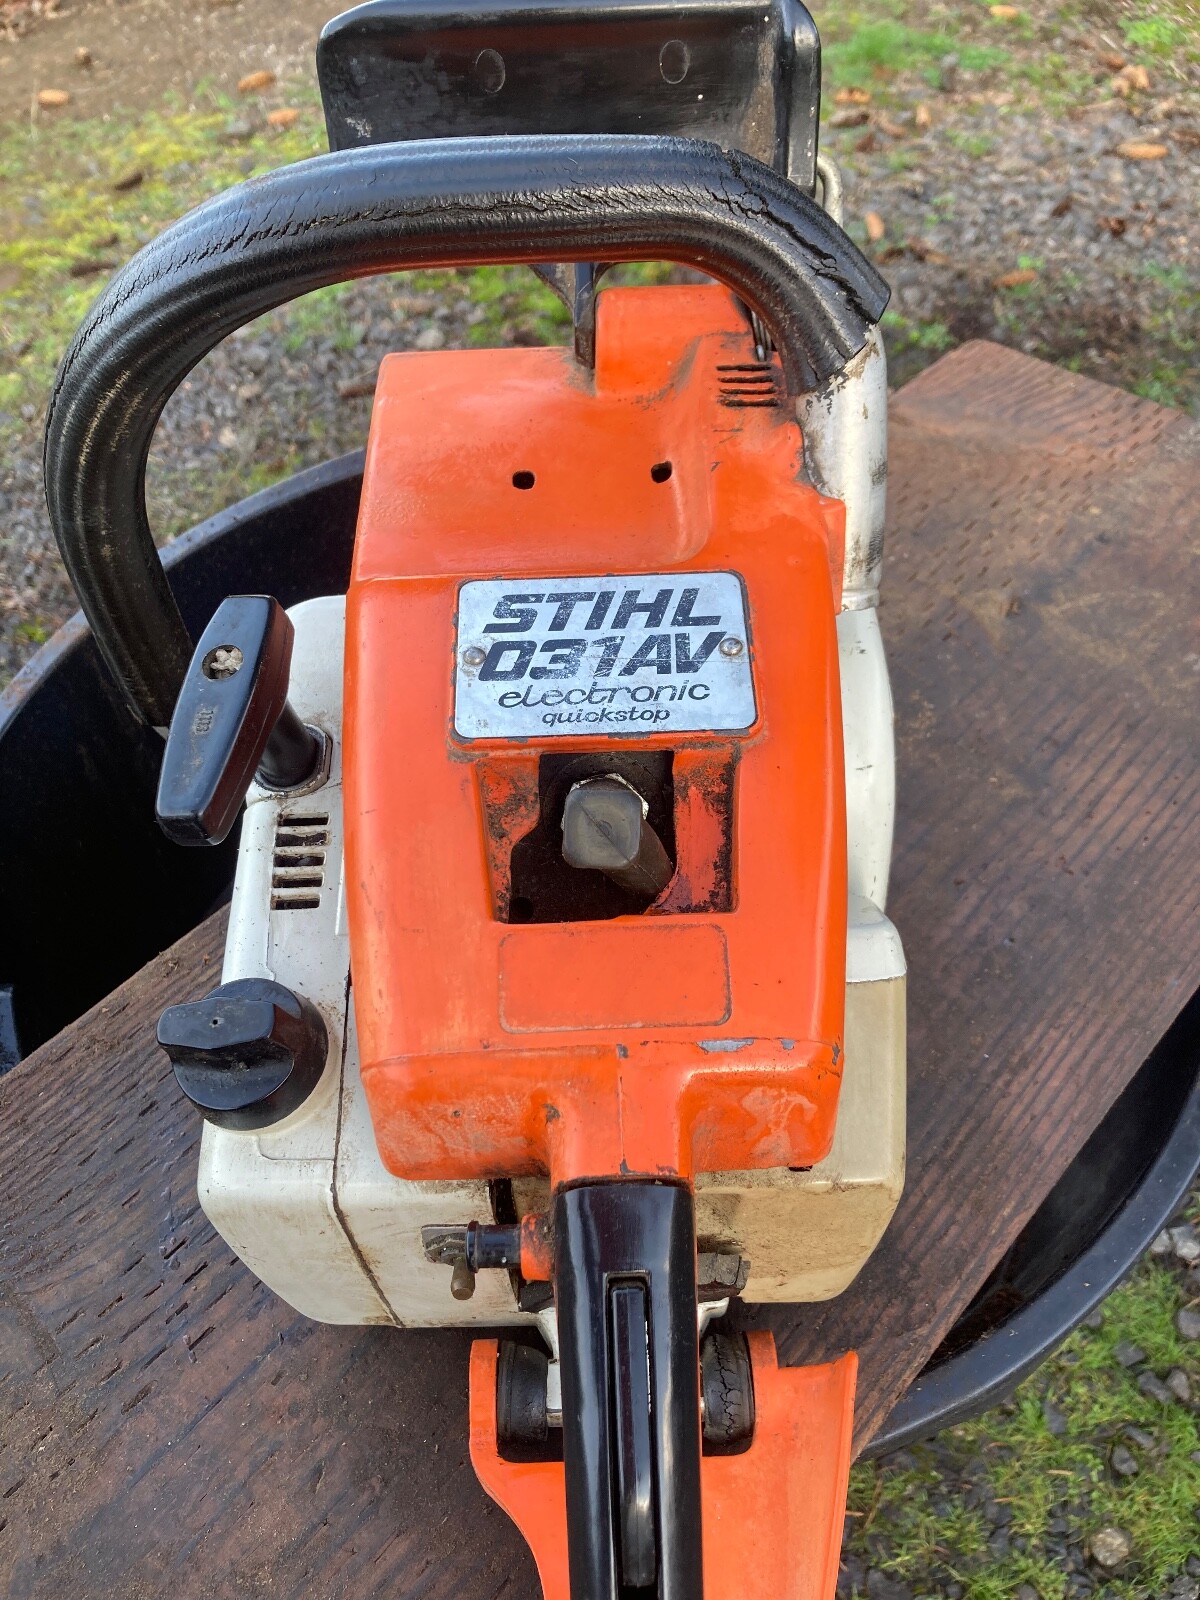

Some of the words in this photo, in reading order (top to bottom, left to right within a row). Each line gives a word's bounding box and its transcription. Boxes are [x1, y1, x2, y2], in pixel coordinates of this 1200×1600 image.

[482, 588, 722, 633] STIHL
[478, 631, 727, 681] 031AV
[498, 679, 710, 708] electronic
[542, 707, 670, 727] quickstop
